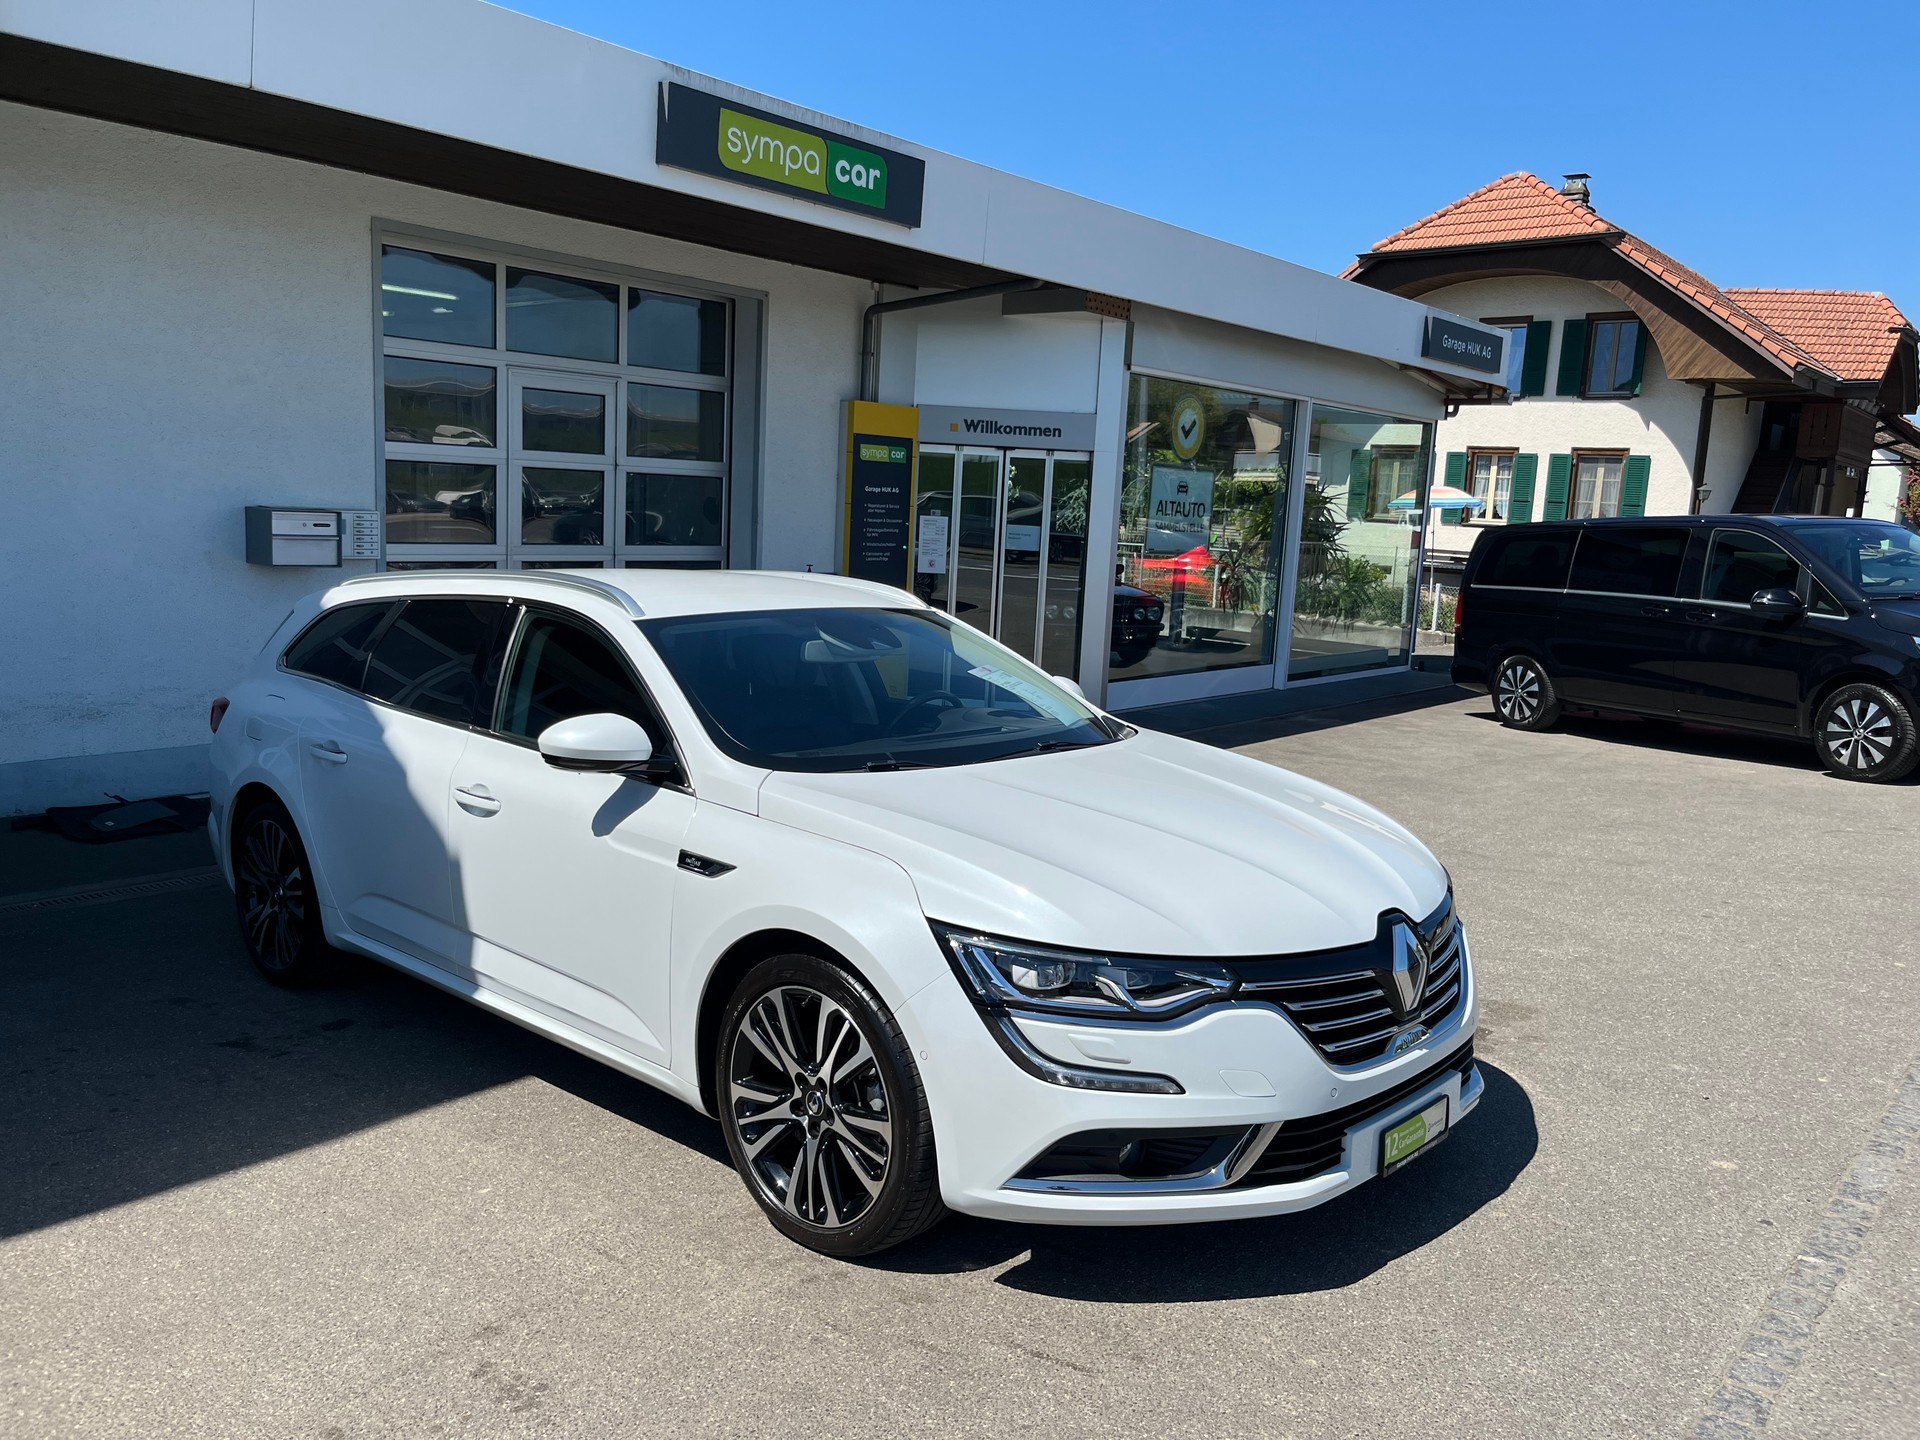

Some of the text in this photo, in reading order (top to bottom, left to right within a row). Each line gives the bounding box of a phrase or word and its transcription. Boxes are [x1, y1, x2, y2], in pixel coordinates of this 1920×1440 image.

[727, 126, 881, 190] sympa car
[1442, 334, 1492, 359] Garage HUK AG
[963, 418, 1062, 438] Willkommen
[861, 448, 905, 459] sympa car
[864, 485, 881, 493] Garage
[1155, 499, 1206, 518] ALTAUTO
[1154, 520, 1205, 534] SAMMELSTELLE
[1385, 1132, 1399, 1159] 12
